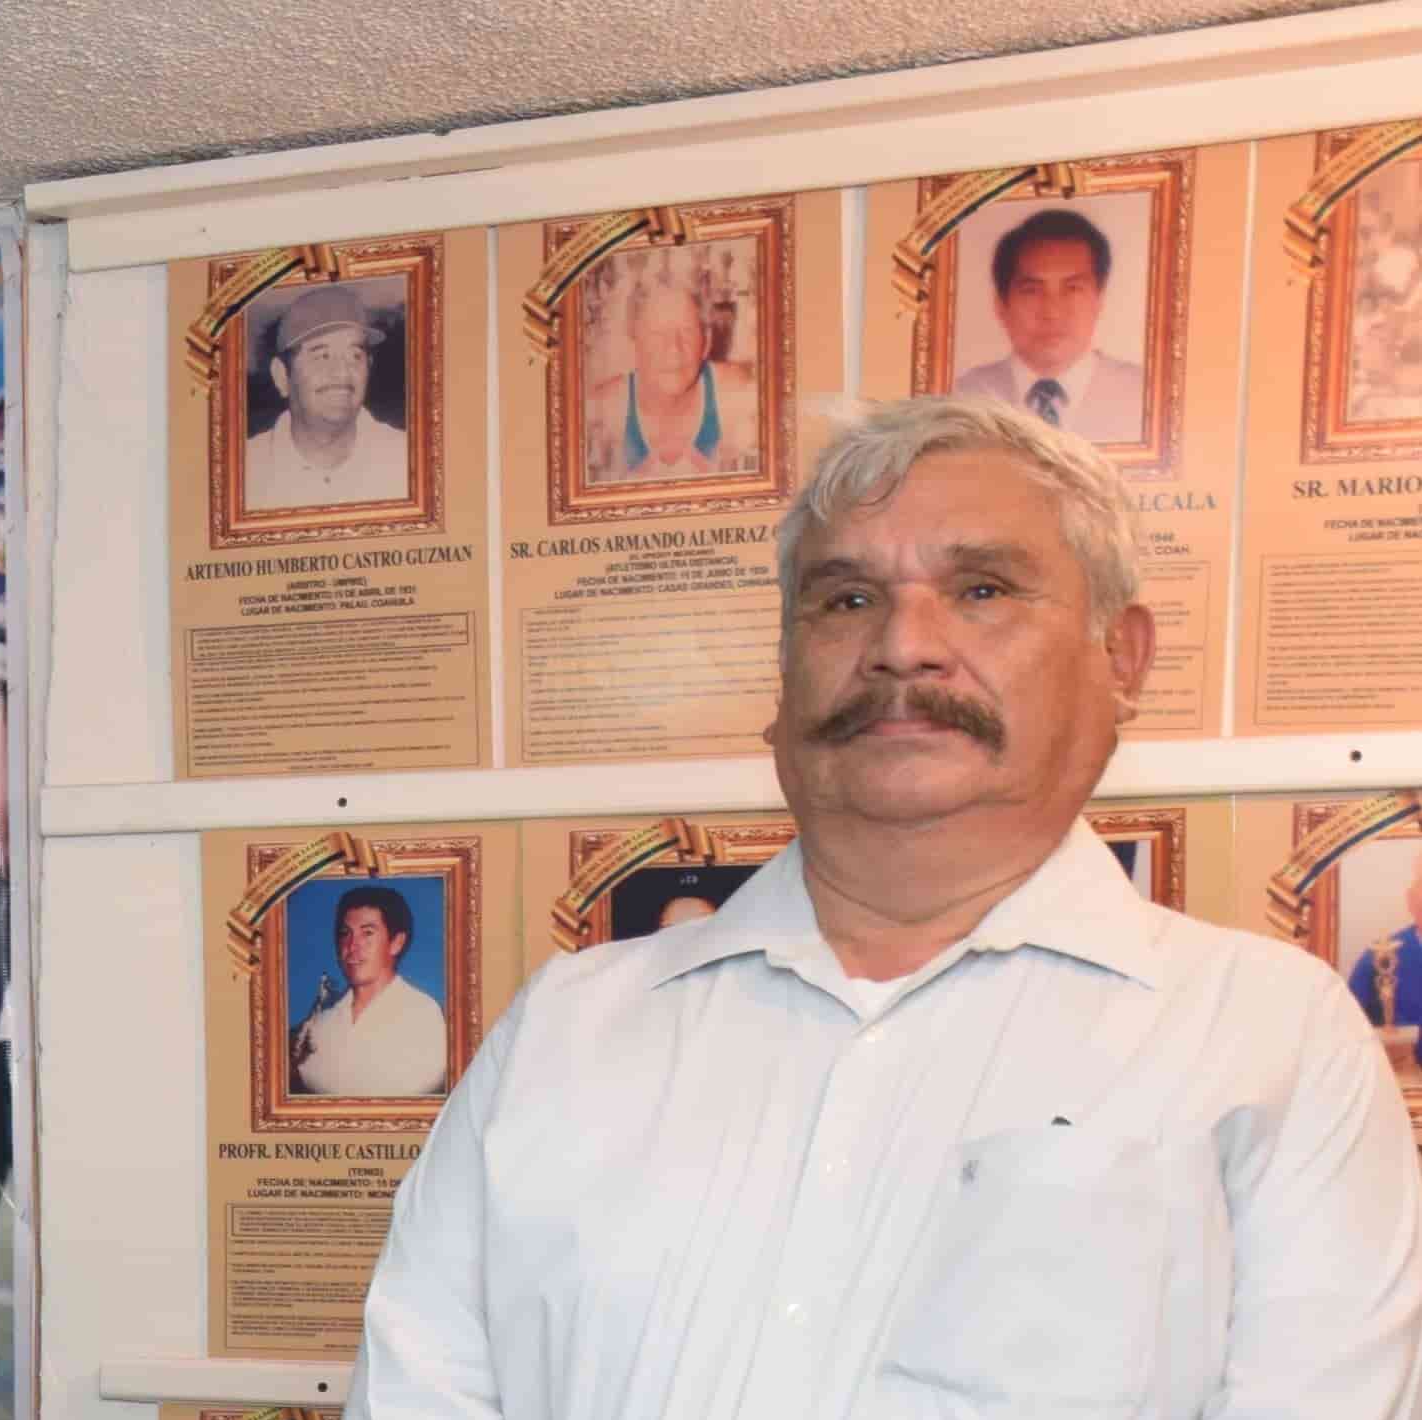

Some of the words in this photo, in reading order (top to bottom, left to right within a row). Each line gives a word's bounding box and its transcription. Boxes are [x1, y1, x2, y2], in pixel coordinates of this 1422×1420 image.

[1138, 491, 1218, 512] LCALA
[510, 542, 533, 560] SR.
[537, 537, 600, 557] CARLOS
[605, 531, 685, 553] ARMANDO
[689, 525, 768, 547] ALMERAZ
[187, 560, 252, 581] ARTEMIO
[257, 554, 338, 576] HUMBERTO
[342, 550, 403, 570] CASTRO
[406, 543, 473, 564] GUZMAN
[219, 1143, 272, 1160] PROFR.
[275, 1143, 341, 1162] ENRIQUE
[345, 1143, 420, 1160] CASTILLO
